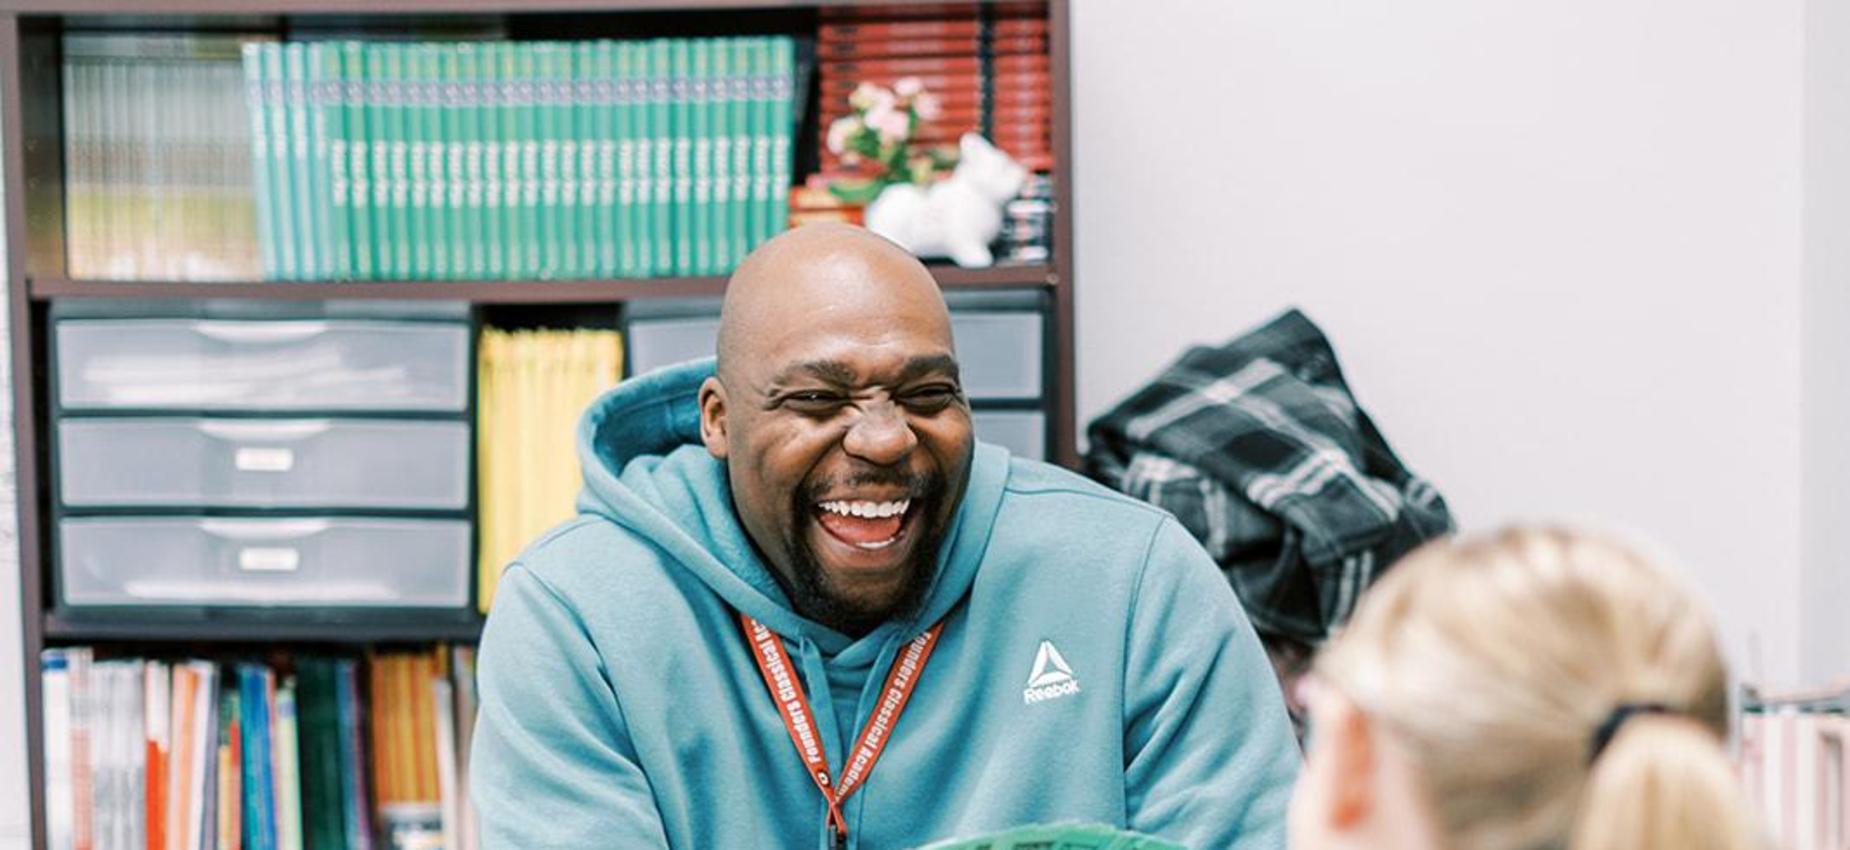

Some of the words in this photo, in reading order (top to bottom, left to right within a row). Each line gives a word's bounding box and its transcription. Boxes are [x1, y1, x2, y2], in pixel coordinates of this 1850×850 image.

[760, 638, 797, 701] Classical
[894, 632, 932, 689] Founders
[1023, 679, 1081, 704] Reebok
[786, 700, 821, 763] Founders
[865, 687, 903, 750] Classical
